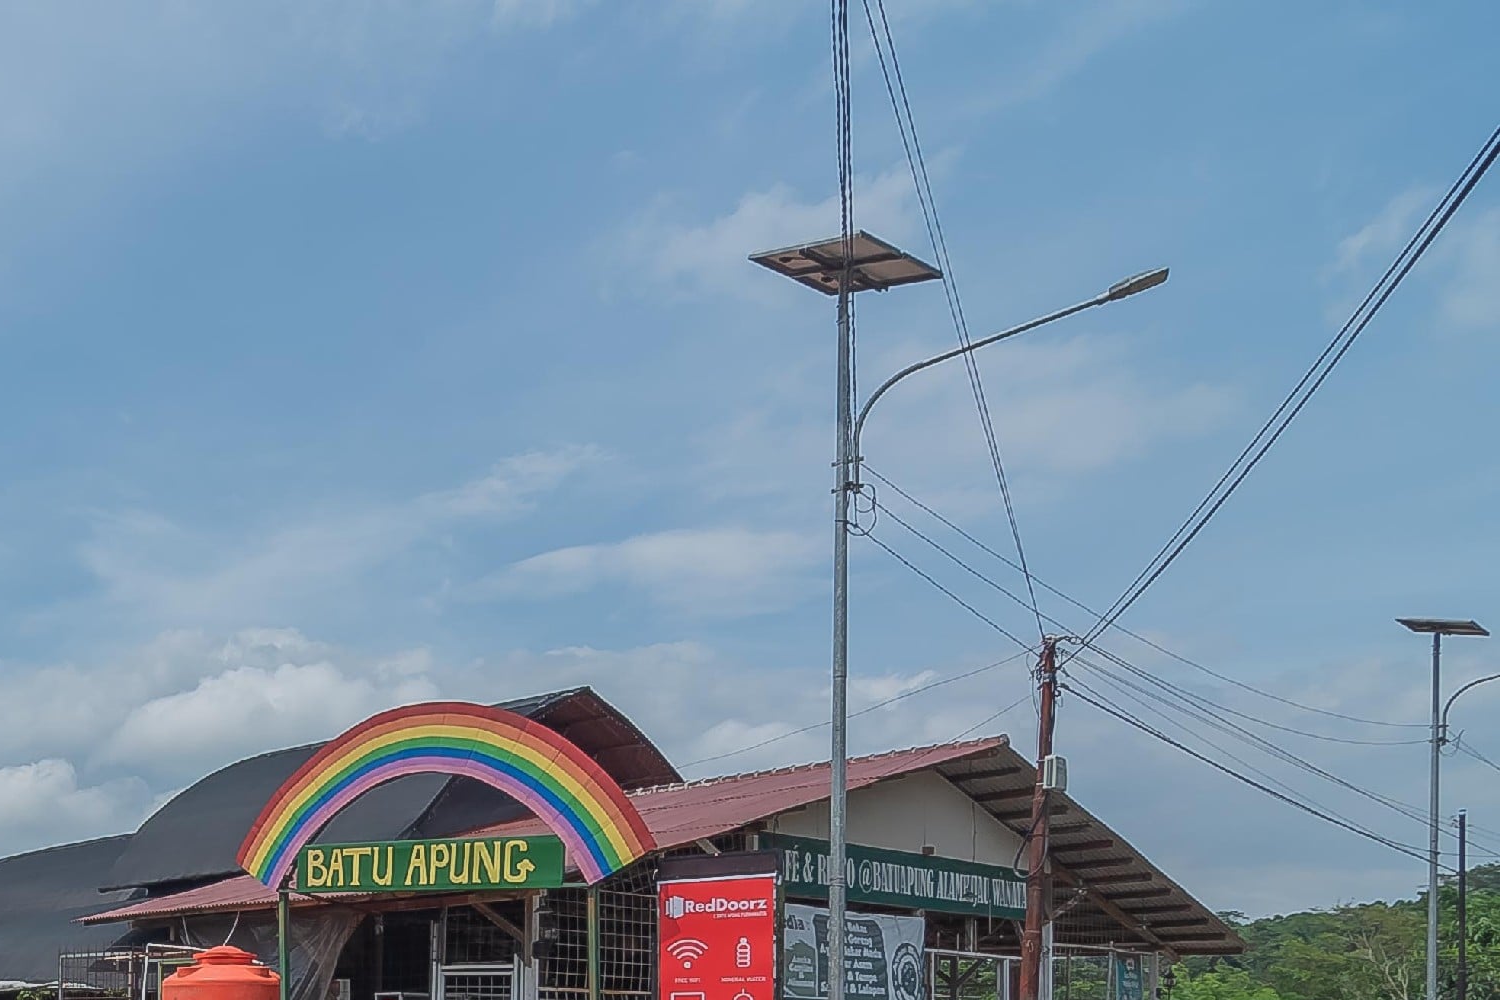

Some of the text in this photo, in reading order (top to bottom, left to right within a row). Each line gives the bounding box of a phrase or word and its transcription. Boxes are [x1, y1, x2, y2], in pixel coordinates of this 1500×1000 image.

[307, 840, 535, 887] BATU APUNG
[783, 844, 799, 882] FÉ
[803, 852, 814, 883] &
[859, 859, 934, 899] @BATUAPUNG
[685, 898, 768, 913] RedDoorz
